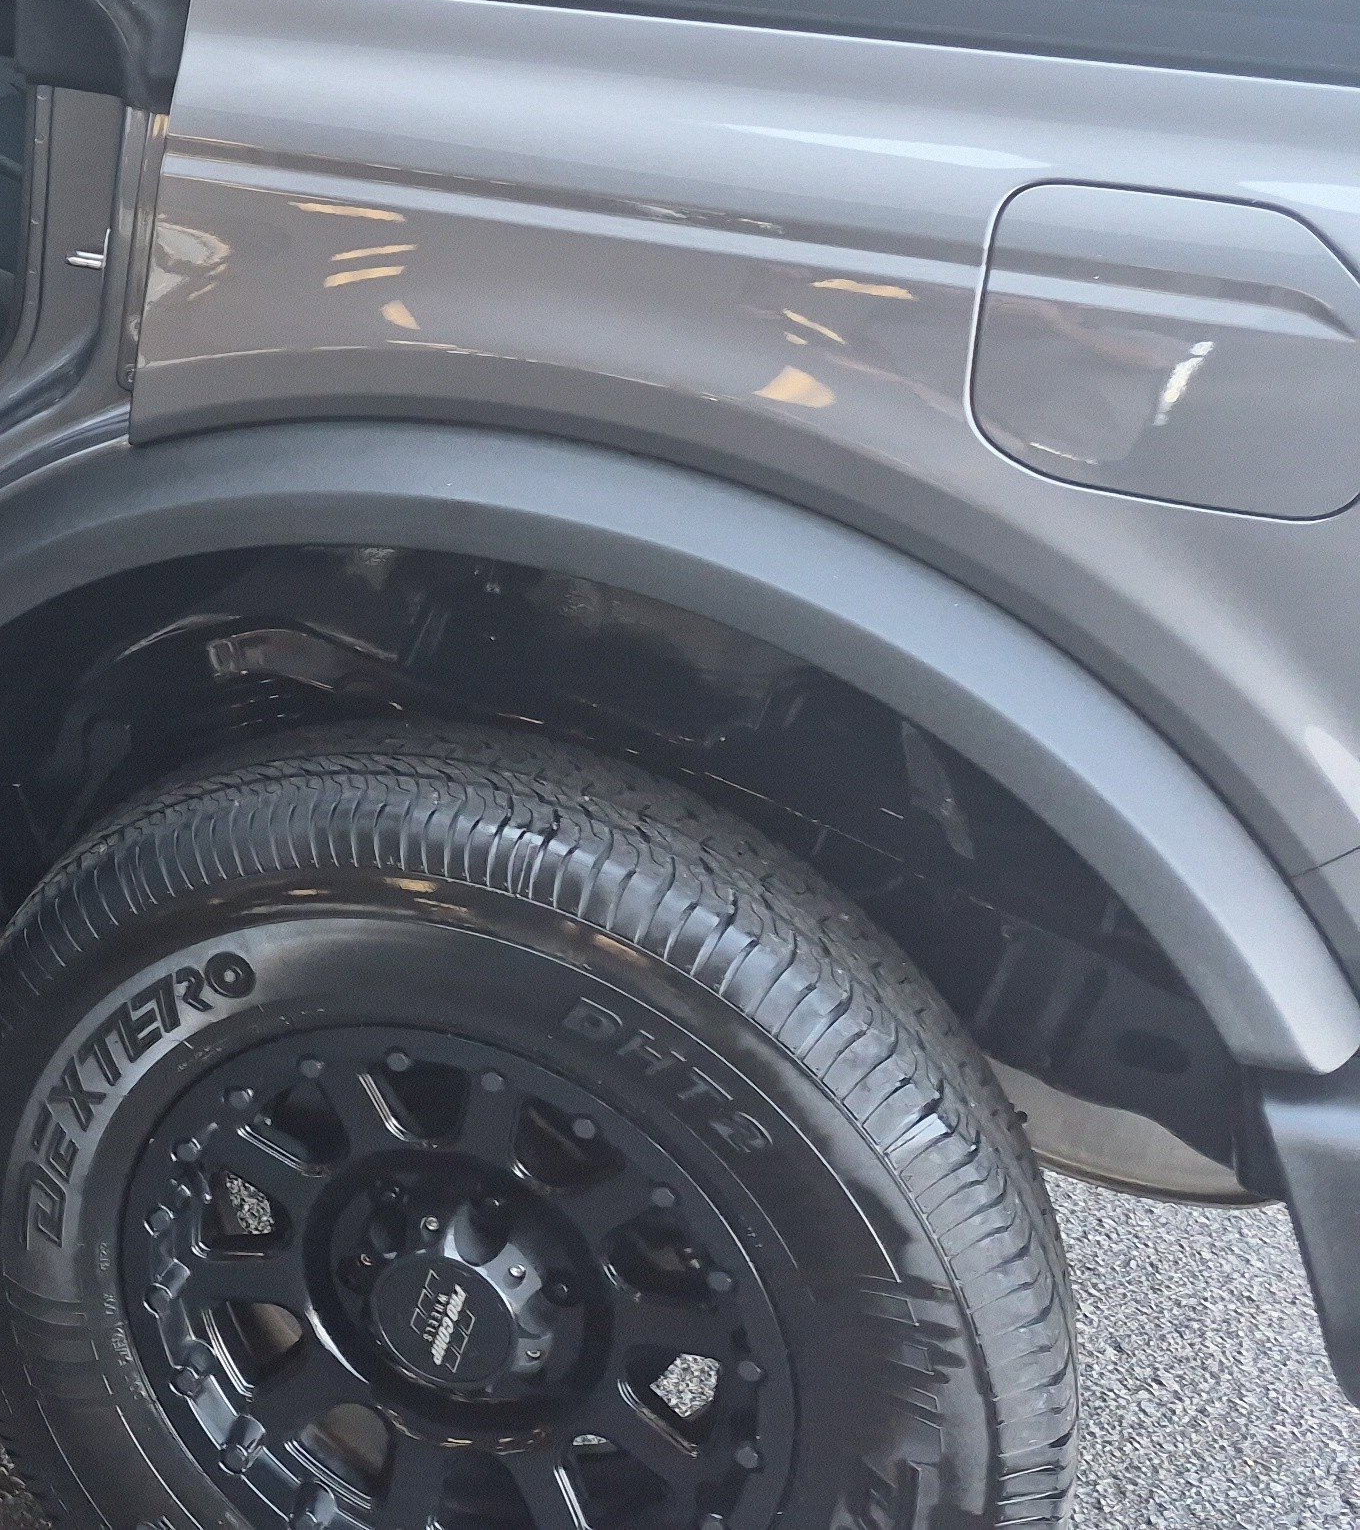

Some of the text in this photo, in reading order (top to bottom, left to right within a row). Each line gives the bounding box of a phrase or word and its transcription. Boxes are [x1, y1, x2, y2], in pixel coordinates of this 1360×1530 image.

[26, 951, 257, 1250] DEXTERO
[423, 1292, 449, 1342] WHEELS
[431, 1283, 467, 1366] PRO COMP
